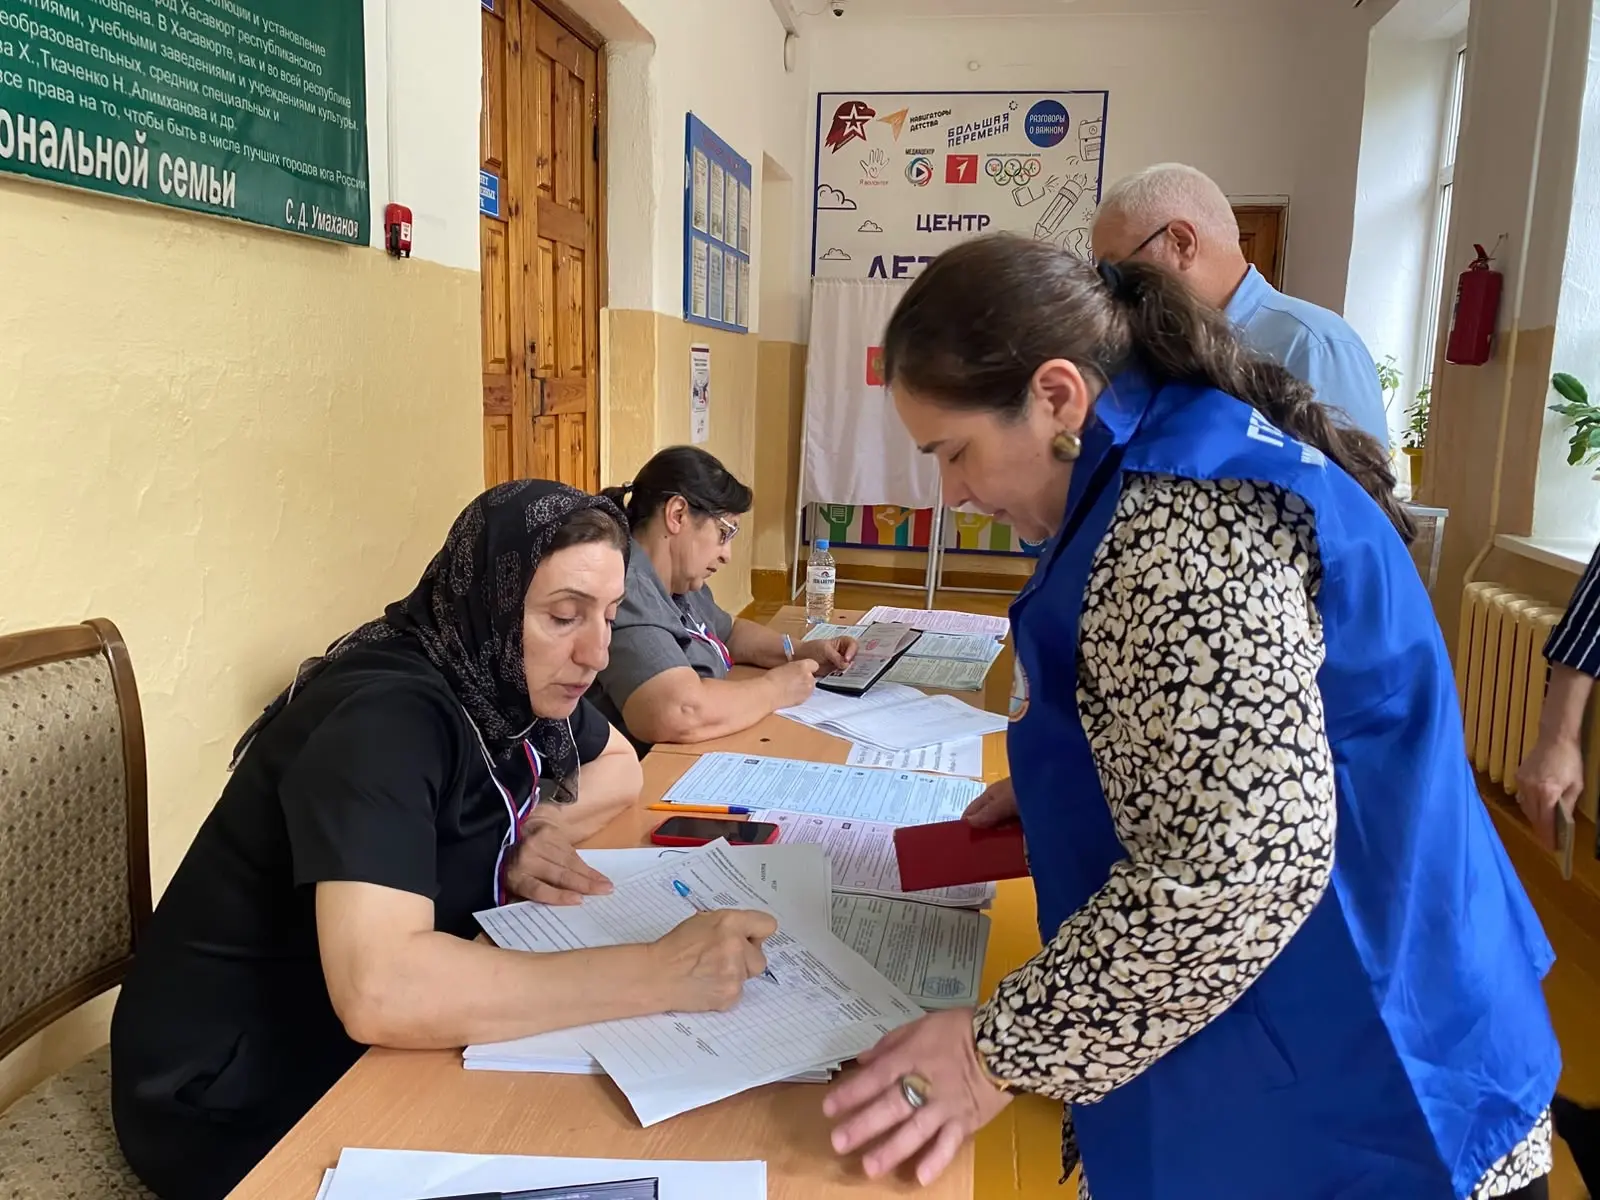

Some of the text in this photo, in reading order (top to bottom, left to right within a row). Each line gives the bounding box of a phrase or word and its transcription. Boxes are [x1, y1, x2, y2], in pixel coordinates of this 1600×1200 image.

[181, 0, 235, 38] Хасавюрт
[238, 29, 322, 76] республиканского
[253, 13, 260, 26] и
[262, 17, 326, 57] установление
[88, 15, 157, 53] учебными
[160, 44, 236, 84] заведениями
[239, 75, 246, 88] и
[248, 78, 316, 115] учреждениями
[158, 13, 167, 31] В
[171, 19, 236, 63] Хасавюрте,
[238, 52, 257, 70] как
[259, 60, 266, 72] и
[267, 64, 279, 79] во
[280, 71, 301, 88] всей
[303, 80, 352, 109] республике
[149, 65, 199, 93] средних
[202, 84, 272, 119] специальных
[274, 109, 280, 122] и
[28, 77, 75, 105] права
[79, 94, 97, 111] на
[100, 100, 121, 120] то,
[124, 108, 164, 131] чтобы
[167, 118, 197, 141] быть
[200, 131, 207, 144] в
[209, 134, 241, 154] числе
[243, 144, 280, 167] лучших
[282, 157, 318, 177] городов
[320, 169, 335, 182] юга
[210, 110, 217, 124] и
[219, 115, 237, 131] др.
[910, 119, 939, 132] ДЕТСТВА
[947, 112, 1010, 138] БОЛЬШАЯ
[948, 123, 1009, 148] ПЕРЕМЕНА
[1029, 114, 1066, 123] РАЗГОВОРЫ
[1029, 126, 1064, 135] О ВАЖНОМ
[158, 152, 236, 209] семьи
[285, 198, 359, 239] С. Д. Умаханов
[916, 213, 990, 233] ЦЕНТР
